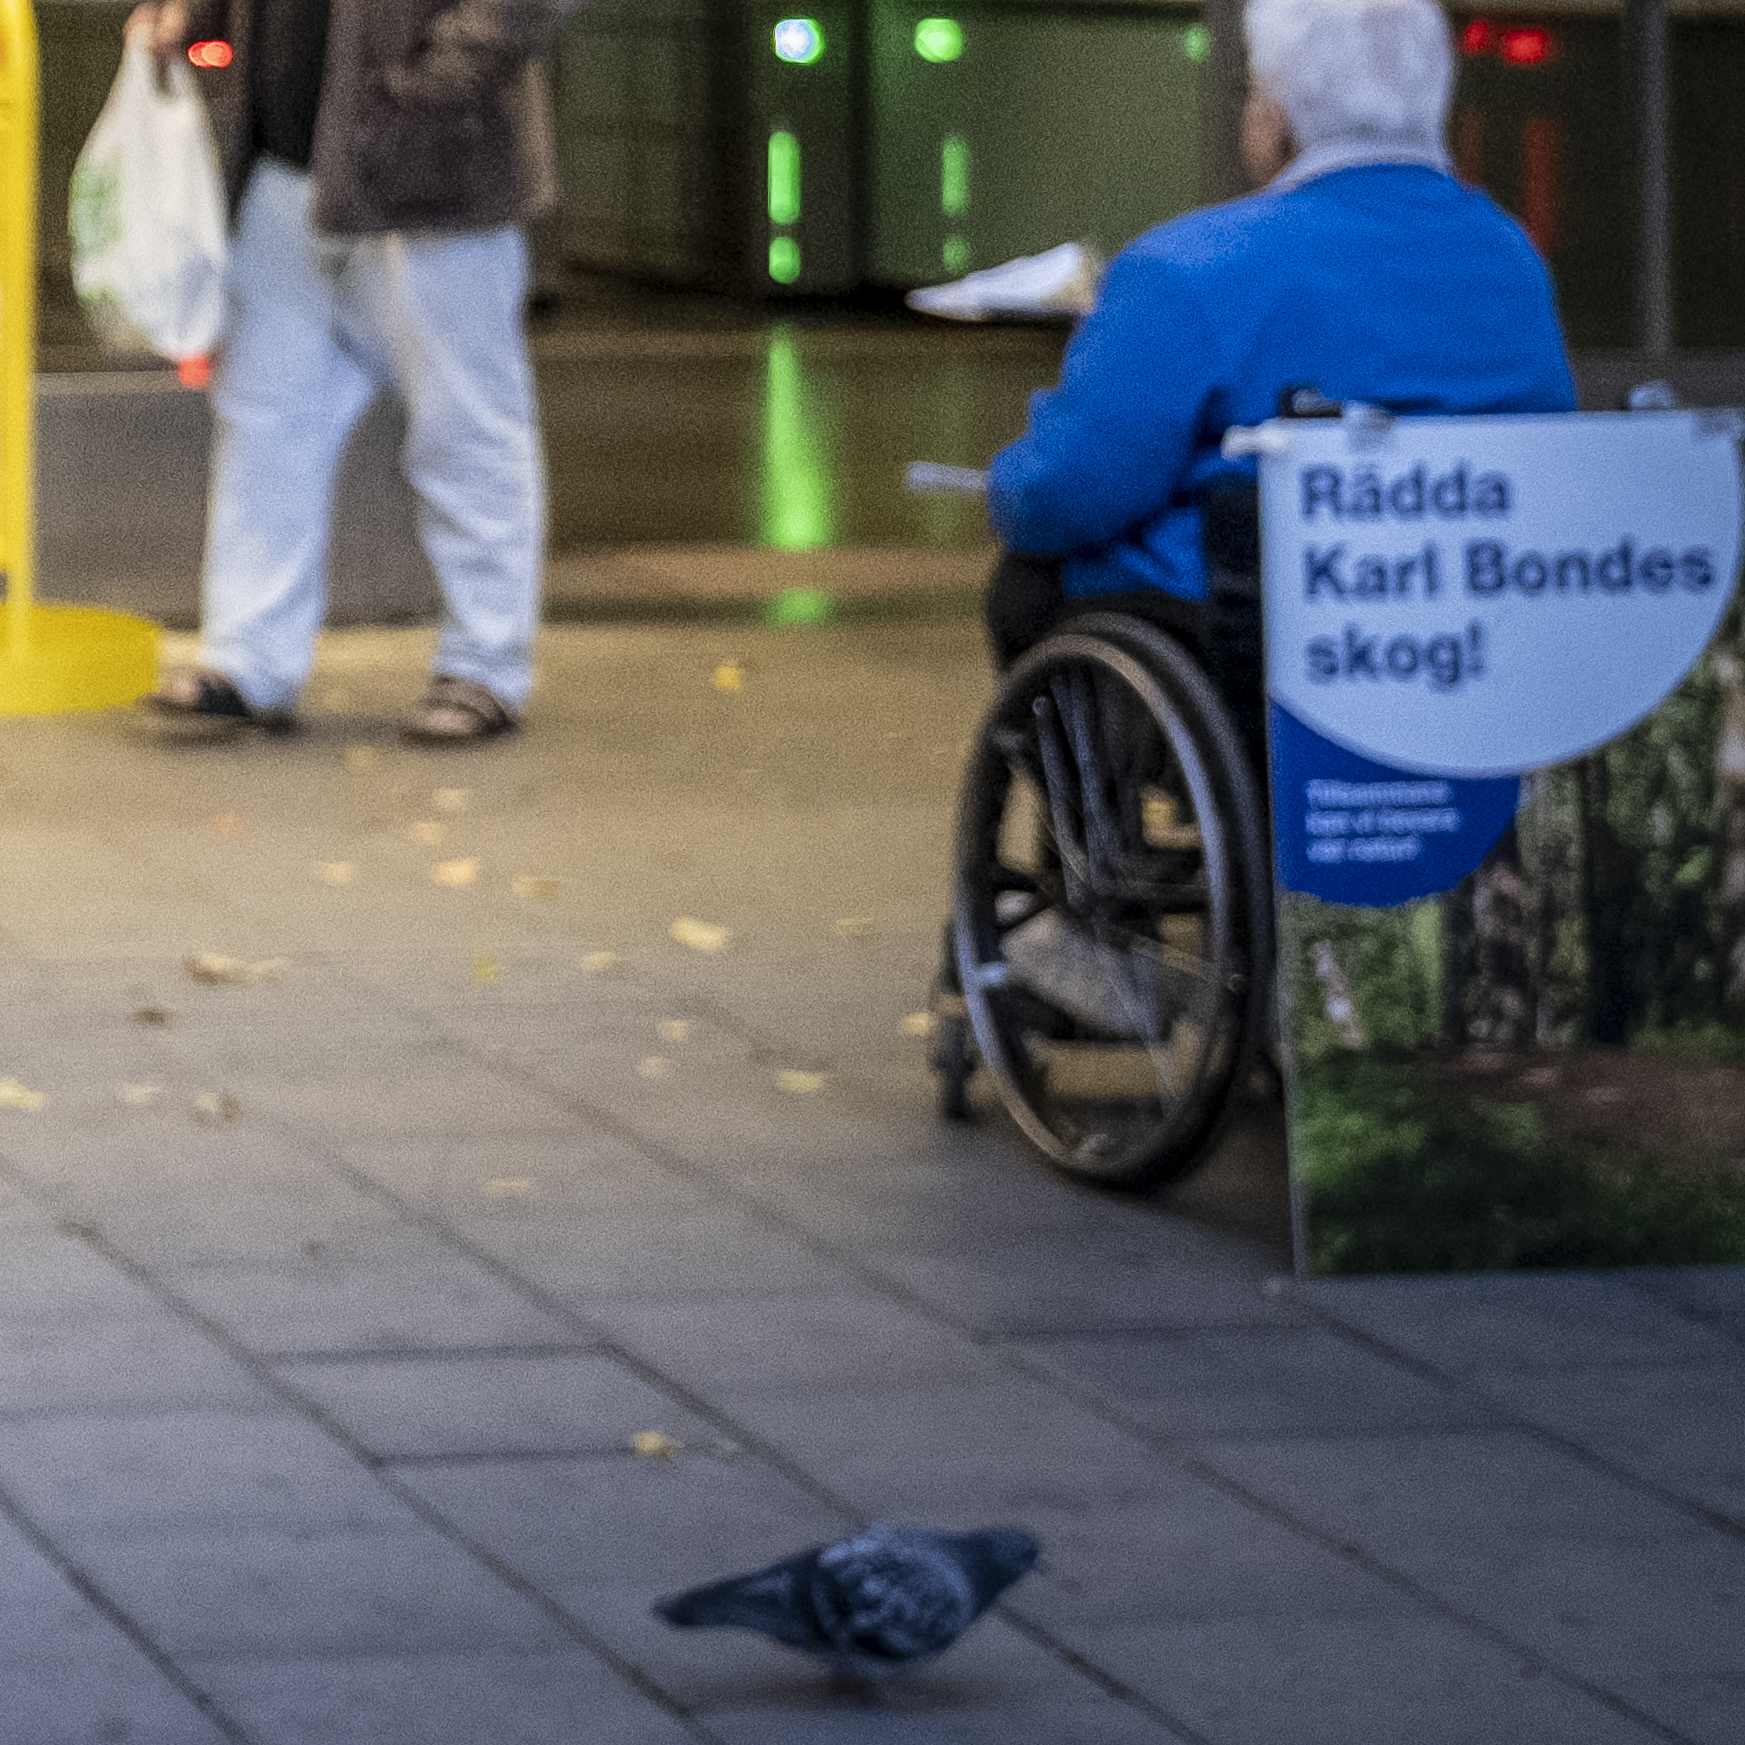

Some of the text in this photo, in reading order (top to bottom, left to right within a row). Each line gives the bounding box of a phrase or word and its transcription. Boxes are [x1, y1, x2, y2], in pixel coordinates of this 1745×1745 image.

[1301, 461, 1511, 518] Rädda
[1303, 534, 1716, 598] Karl Bondes
[1304, 620, 1483, 692] skog!
